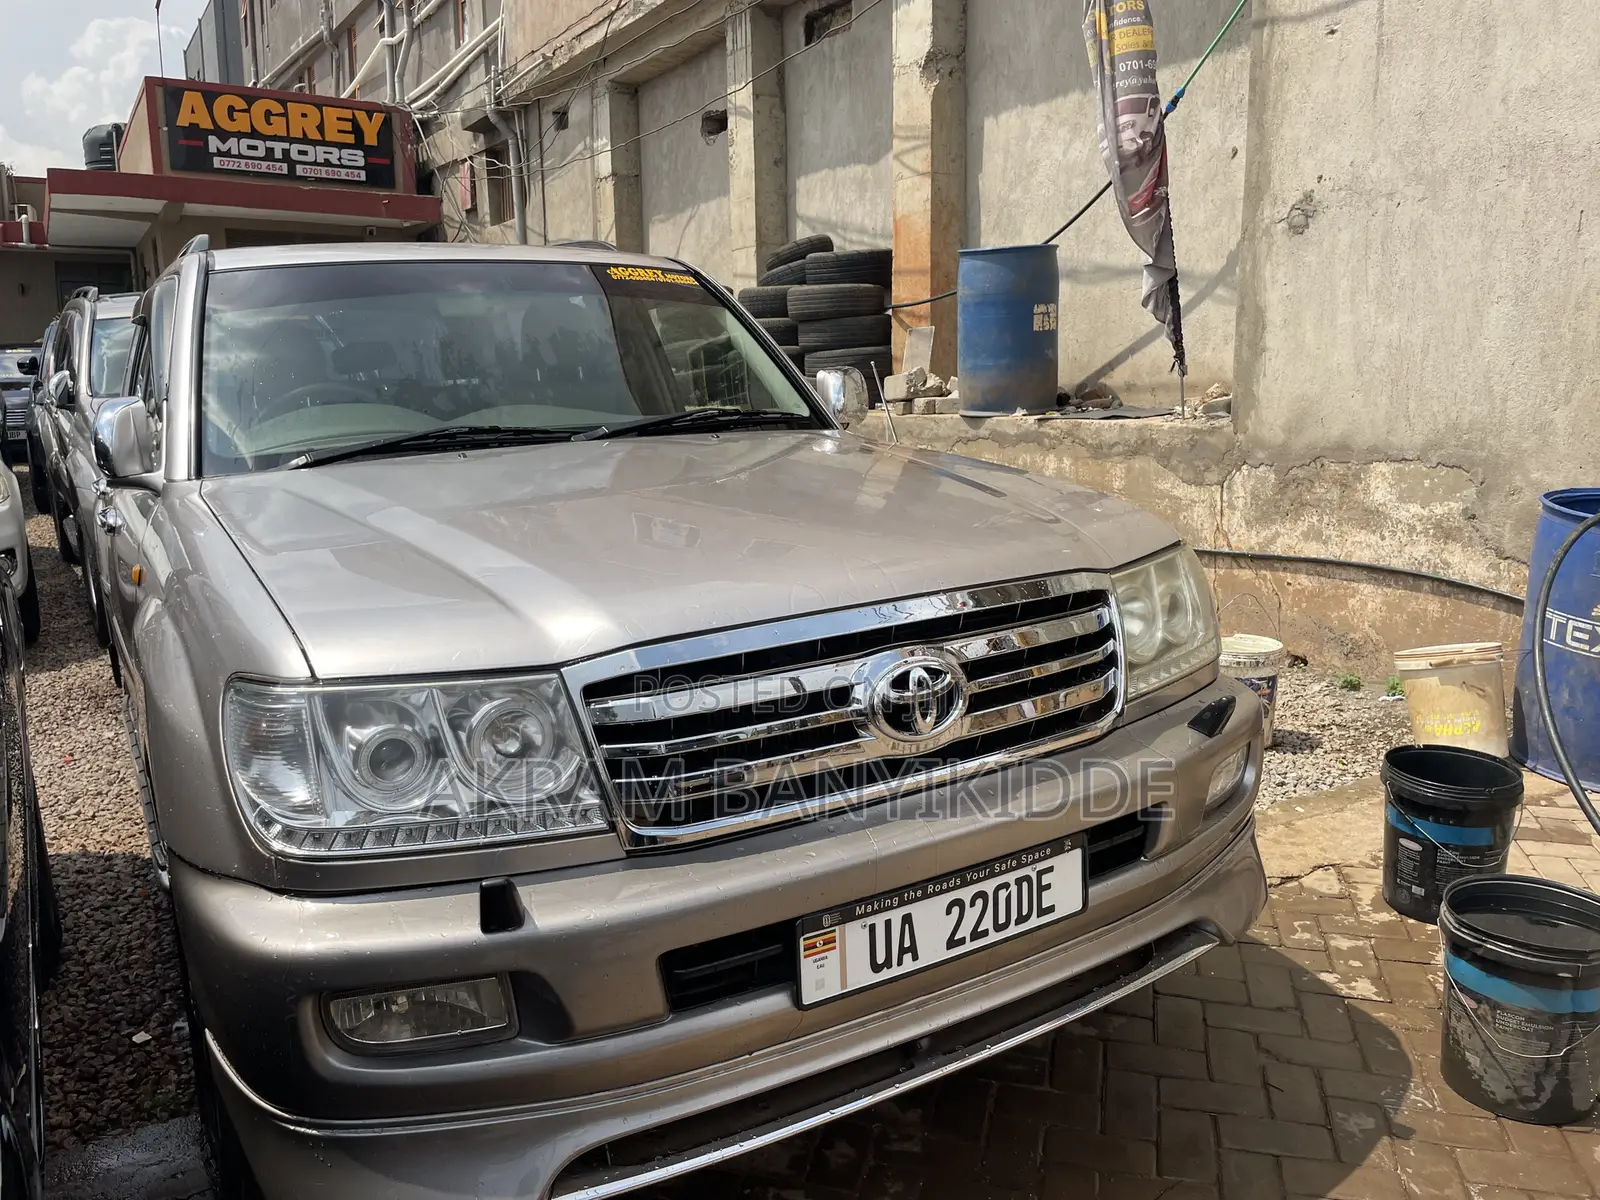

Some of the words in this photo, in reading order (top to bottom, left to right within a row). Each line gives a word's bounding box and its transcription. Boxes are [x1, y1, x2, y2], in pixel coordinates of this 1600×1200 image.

[1116, 41, 1140, 52] Sales
[176, 90, 385, 146] AGGREY
[207, 135, 365, 167] MOTORS
[219, 159, 242, 169] 0772
[244, 161, 263, 170] 690
[265, 163, 284, 172] 454
[302, 167, 322, 176] 0701
[325, 168, 341, 178] 690
[344, 170, 361, 179] 454
[607, 266, 665, 280] AGGREY
[855, 896, 898, 916] Making
[904, 889, 922, 901] the
[927, 877, 961, 894] Roads
[966, 868, 990, 882] Your
[994, 859, 1017, 873] Safe
[1021, 847, 1051, 864] Space
[868, 912, 919, 974] UA
[945, 865, 1056, 951] 220DE
[1496, 1009, 1525, 1021] PLASCON
[1495, 1018, 1534, 1033] UNDERCOAT
[1495, 1023, 1513, 1033] PAINT
[1496, 1014, 1520, 1026] BUDGET
[1521, 1021, 1554, 1031] EMULSION
